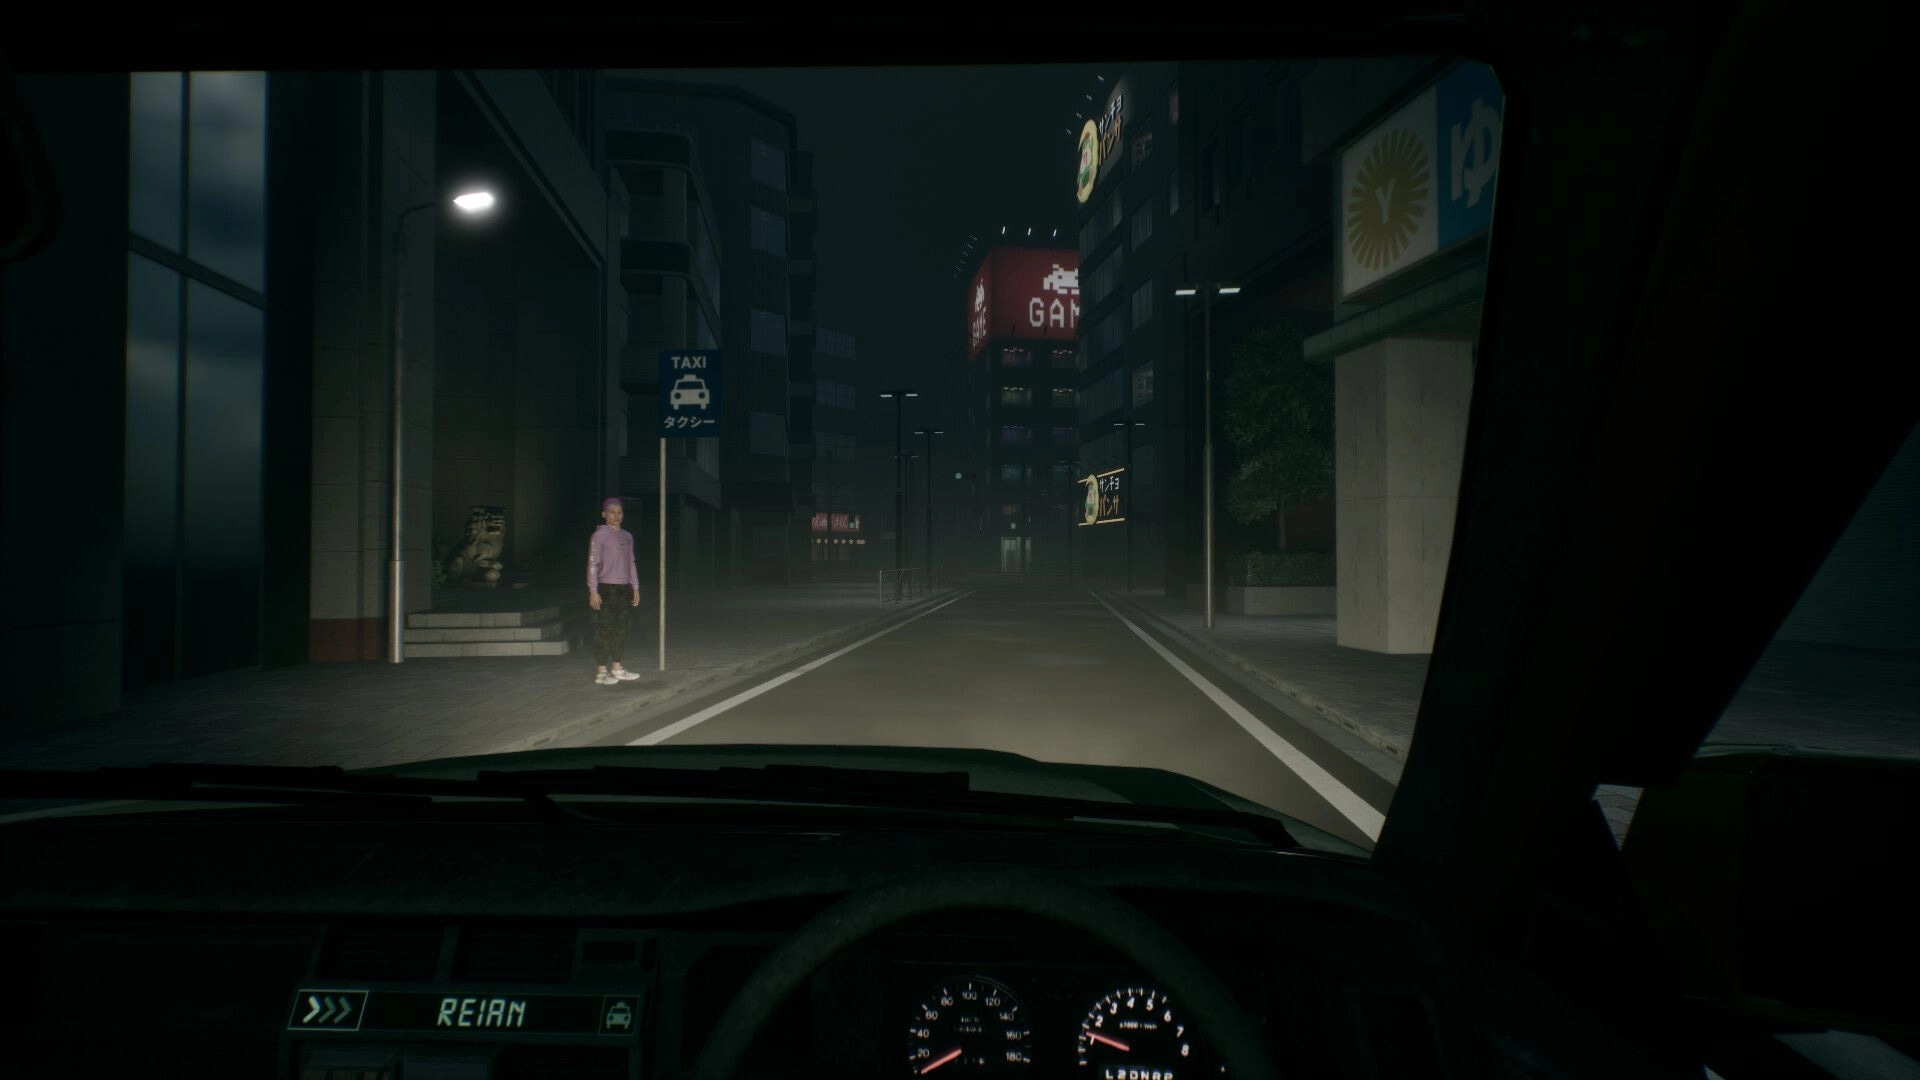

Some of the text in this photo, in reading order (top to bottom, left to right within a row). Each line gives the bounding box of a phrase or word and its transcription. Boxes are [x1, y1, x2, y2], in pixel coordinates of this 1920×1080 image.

[1451, 96, 1500, 208] ゆ
[670, 355, 707, 369] TAXI
[664, 415, 716, 430] タクシー
[984, 997, 1001, 1007] 120
[1109, 1001, 1119, 1016] 3
[436, 997, 527, 1029] REIAN
[1163, 1009, 1173, 1024] 6
[1094, 1014, 1104, 1028] 2
[916, 1027, 930, 1039] 40
[1176, 1025, 1185, 1039] 7
[1180, 1043, 1191, 1058] 8
